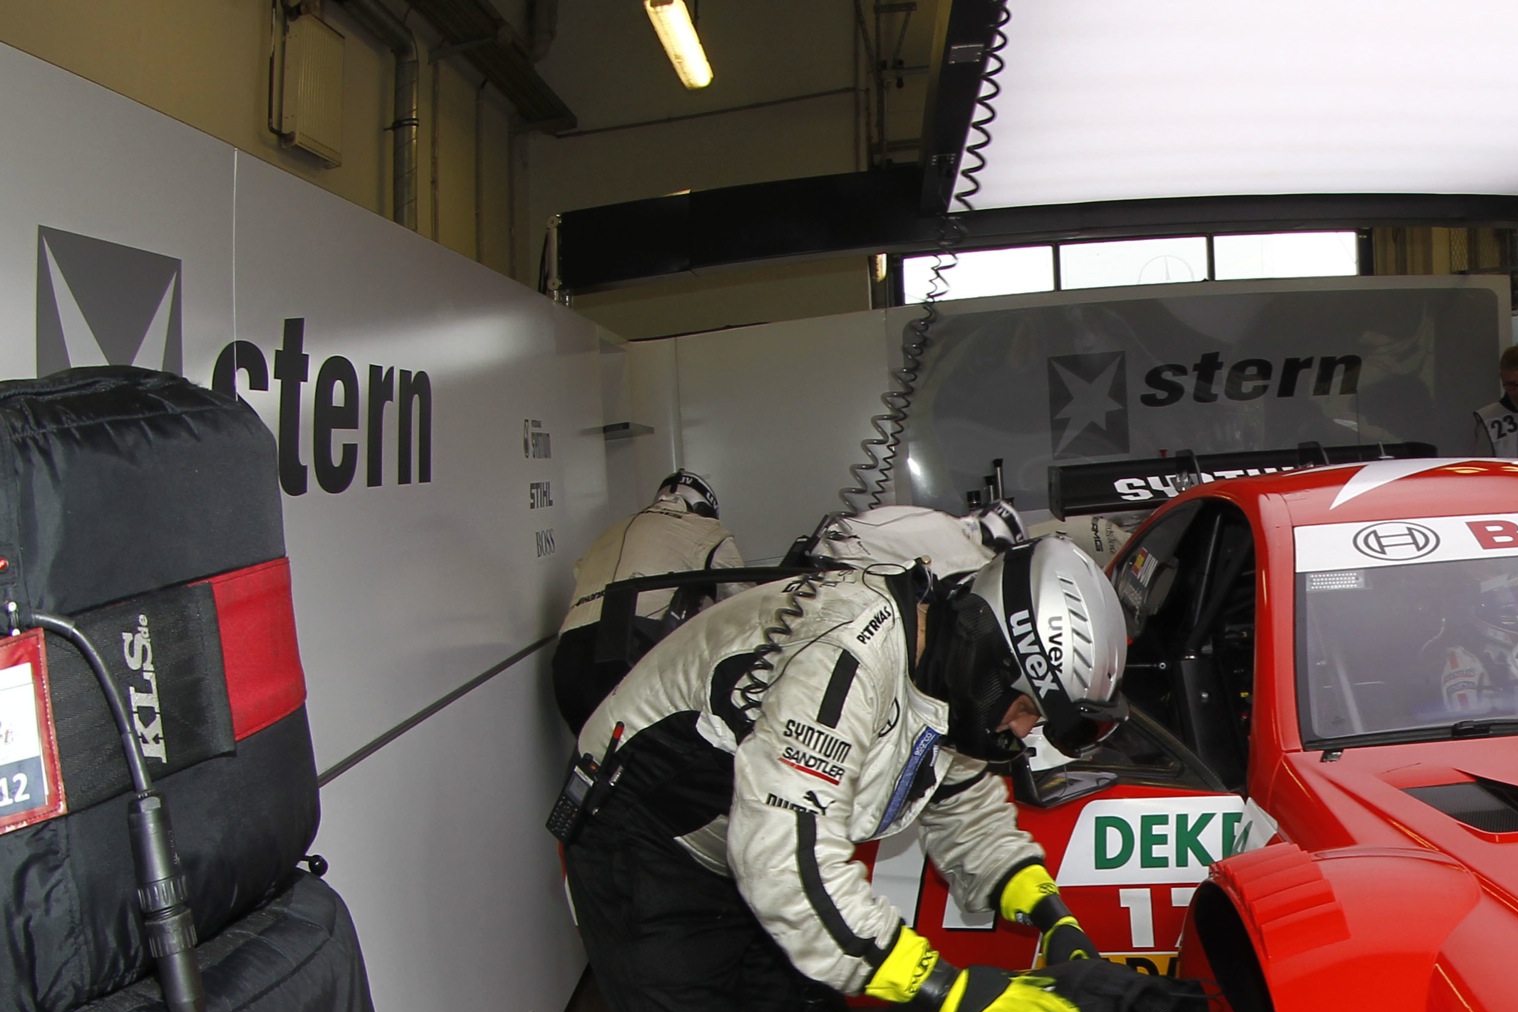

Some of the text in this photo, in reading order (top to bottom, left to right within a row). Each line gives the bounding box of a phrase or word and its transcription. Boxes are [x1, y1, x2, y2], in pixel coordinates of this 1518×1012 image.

[1140, 351, 1362, 407] stern
[1490, 415, 1518, 439] 23
[530, 481, 553, 509] STIHL
[536, 529, 555, 557] BOSS
[1009, 609, 1061, 699] uvex
[1047, 616, 1064, 674] uvex
[782, 747, 845, 780] SANDTLER
[784, 719, 852, 764] SYNTIUM
[1094, 811, 1253, 870] DEKR
